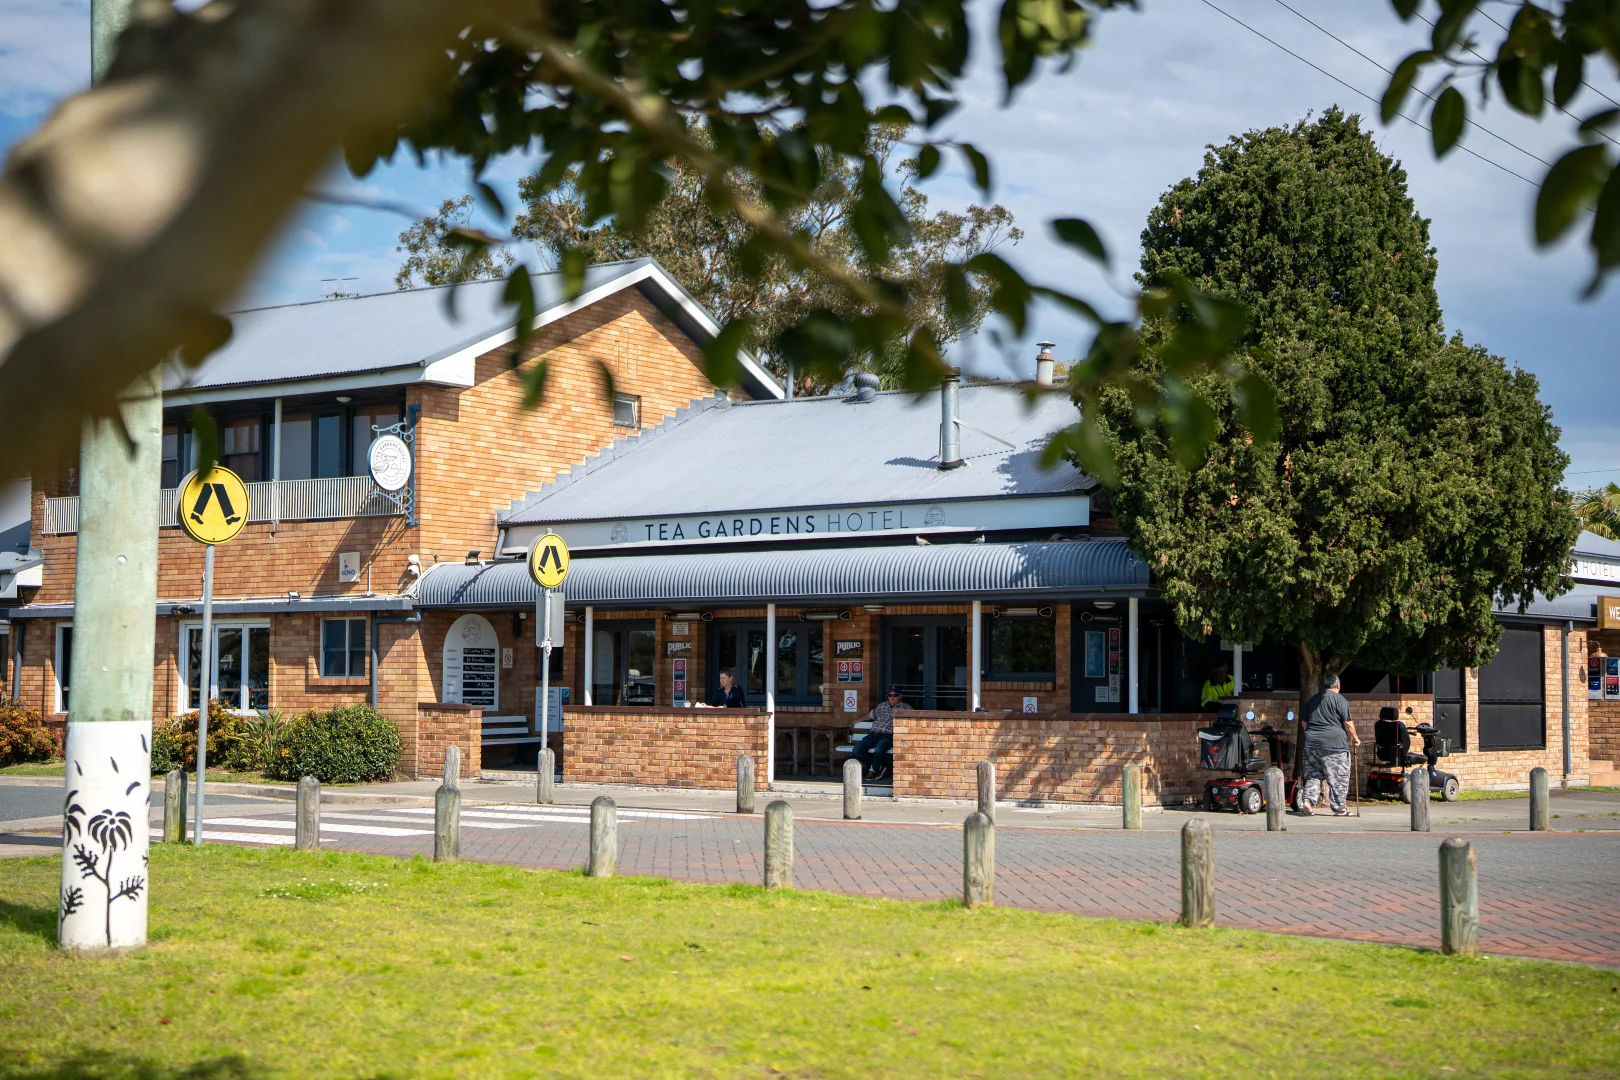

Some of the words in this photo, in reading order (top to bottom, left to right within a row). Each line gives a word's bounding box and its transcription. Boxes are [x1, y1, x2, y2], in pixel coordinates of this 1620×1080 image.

[645, 522, 685, 541] TEA
[698, 515, 815, 539] GARDENS
[827, 510, 909, 533] HOTEL
[1582, 560, 1615, 578] HOTEL
[667, 642, 693, 655] PUBLIC
[836, 641, 861, 655] PUBLIC
